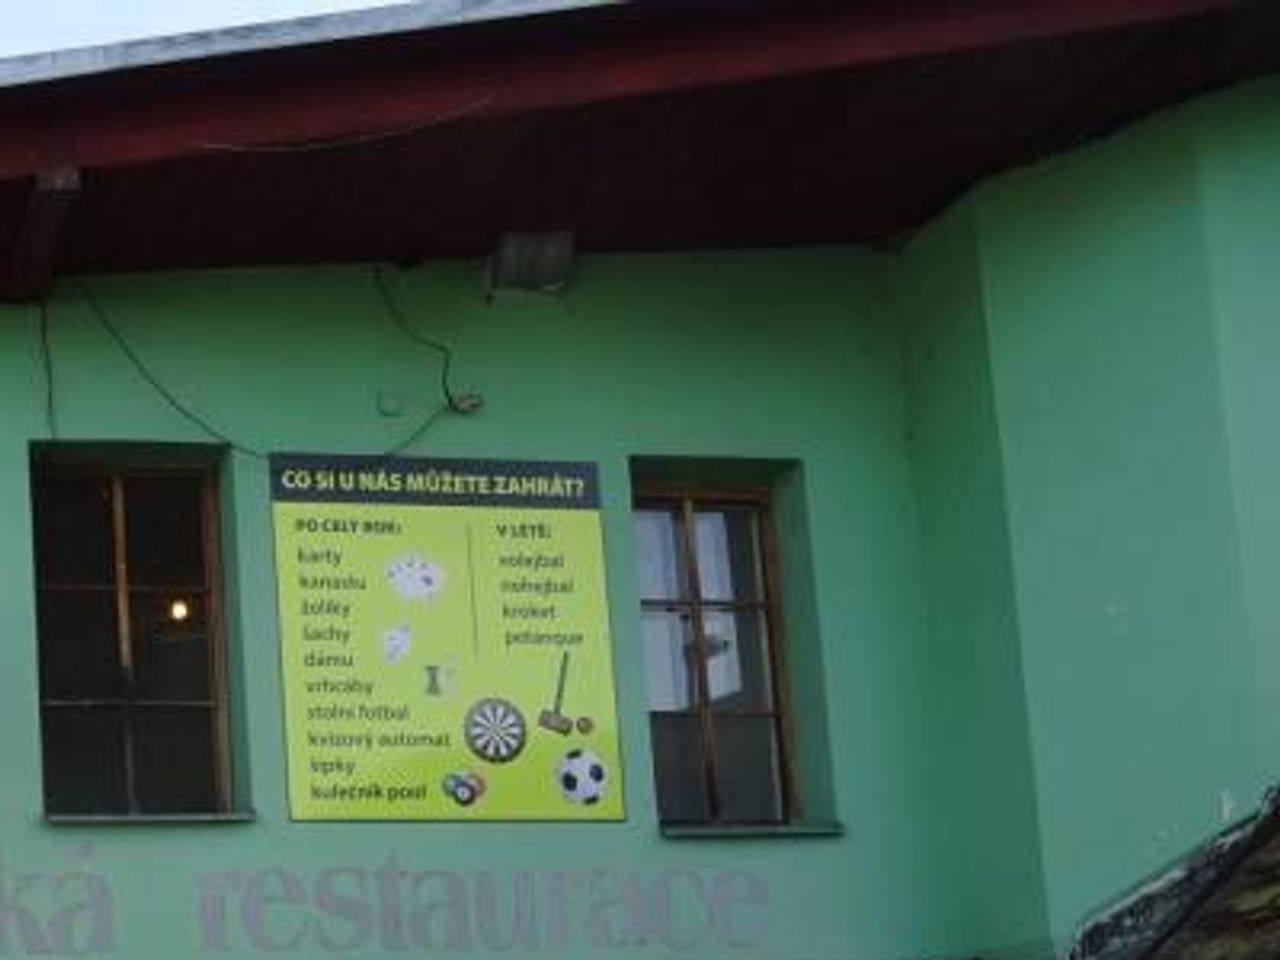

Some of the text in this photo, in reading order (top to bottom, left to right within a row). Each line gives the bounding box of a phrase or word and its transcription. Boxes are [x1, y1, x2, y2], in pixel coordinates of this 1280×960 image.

[281, 468, 585, 498] CO SI U NÁS MŮŽETE ZAHRÁT?
[297, 548, 342, 567] karty
[499, 551, 564, 572] volejbal
[502, 604, 555, 620] kroket
[358, 703, 410, 720] fotbal
[377, 733, 452, 747] automat
[387, 783, 427, 802] pool
[193, 855, 772, 953] restaurace
